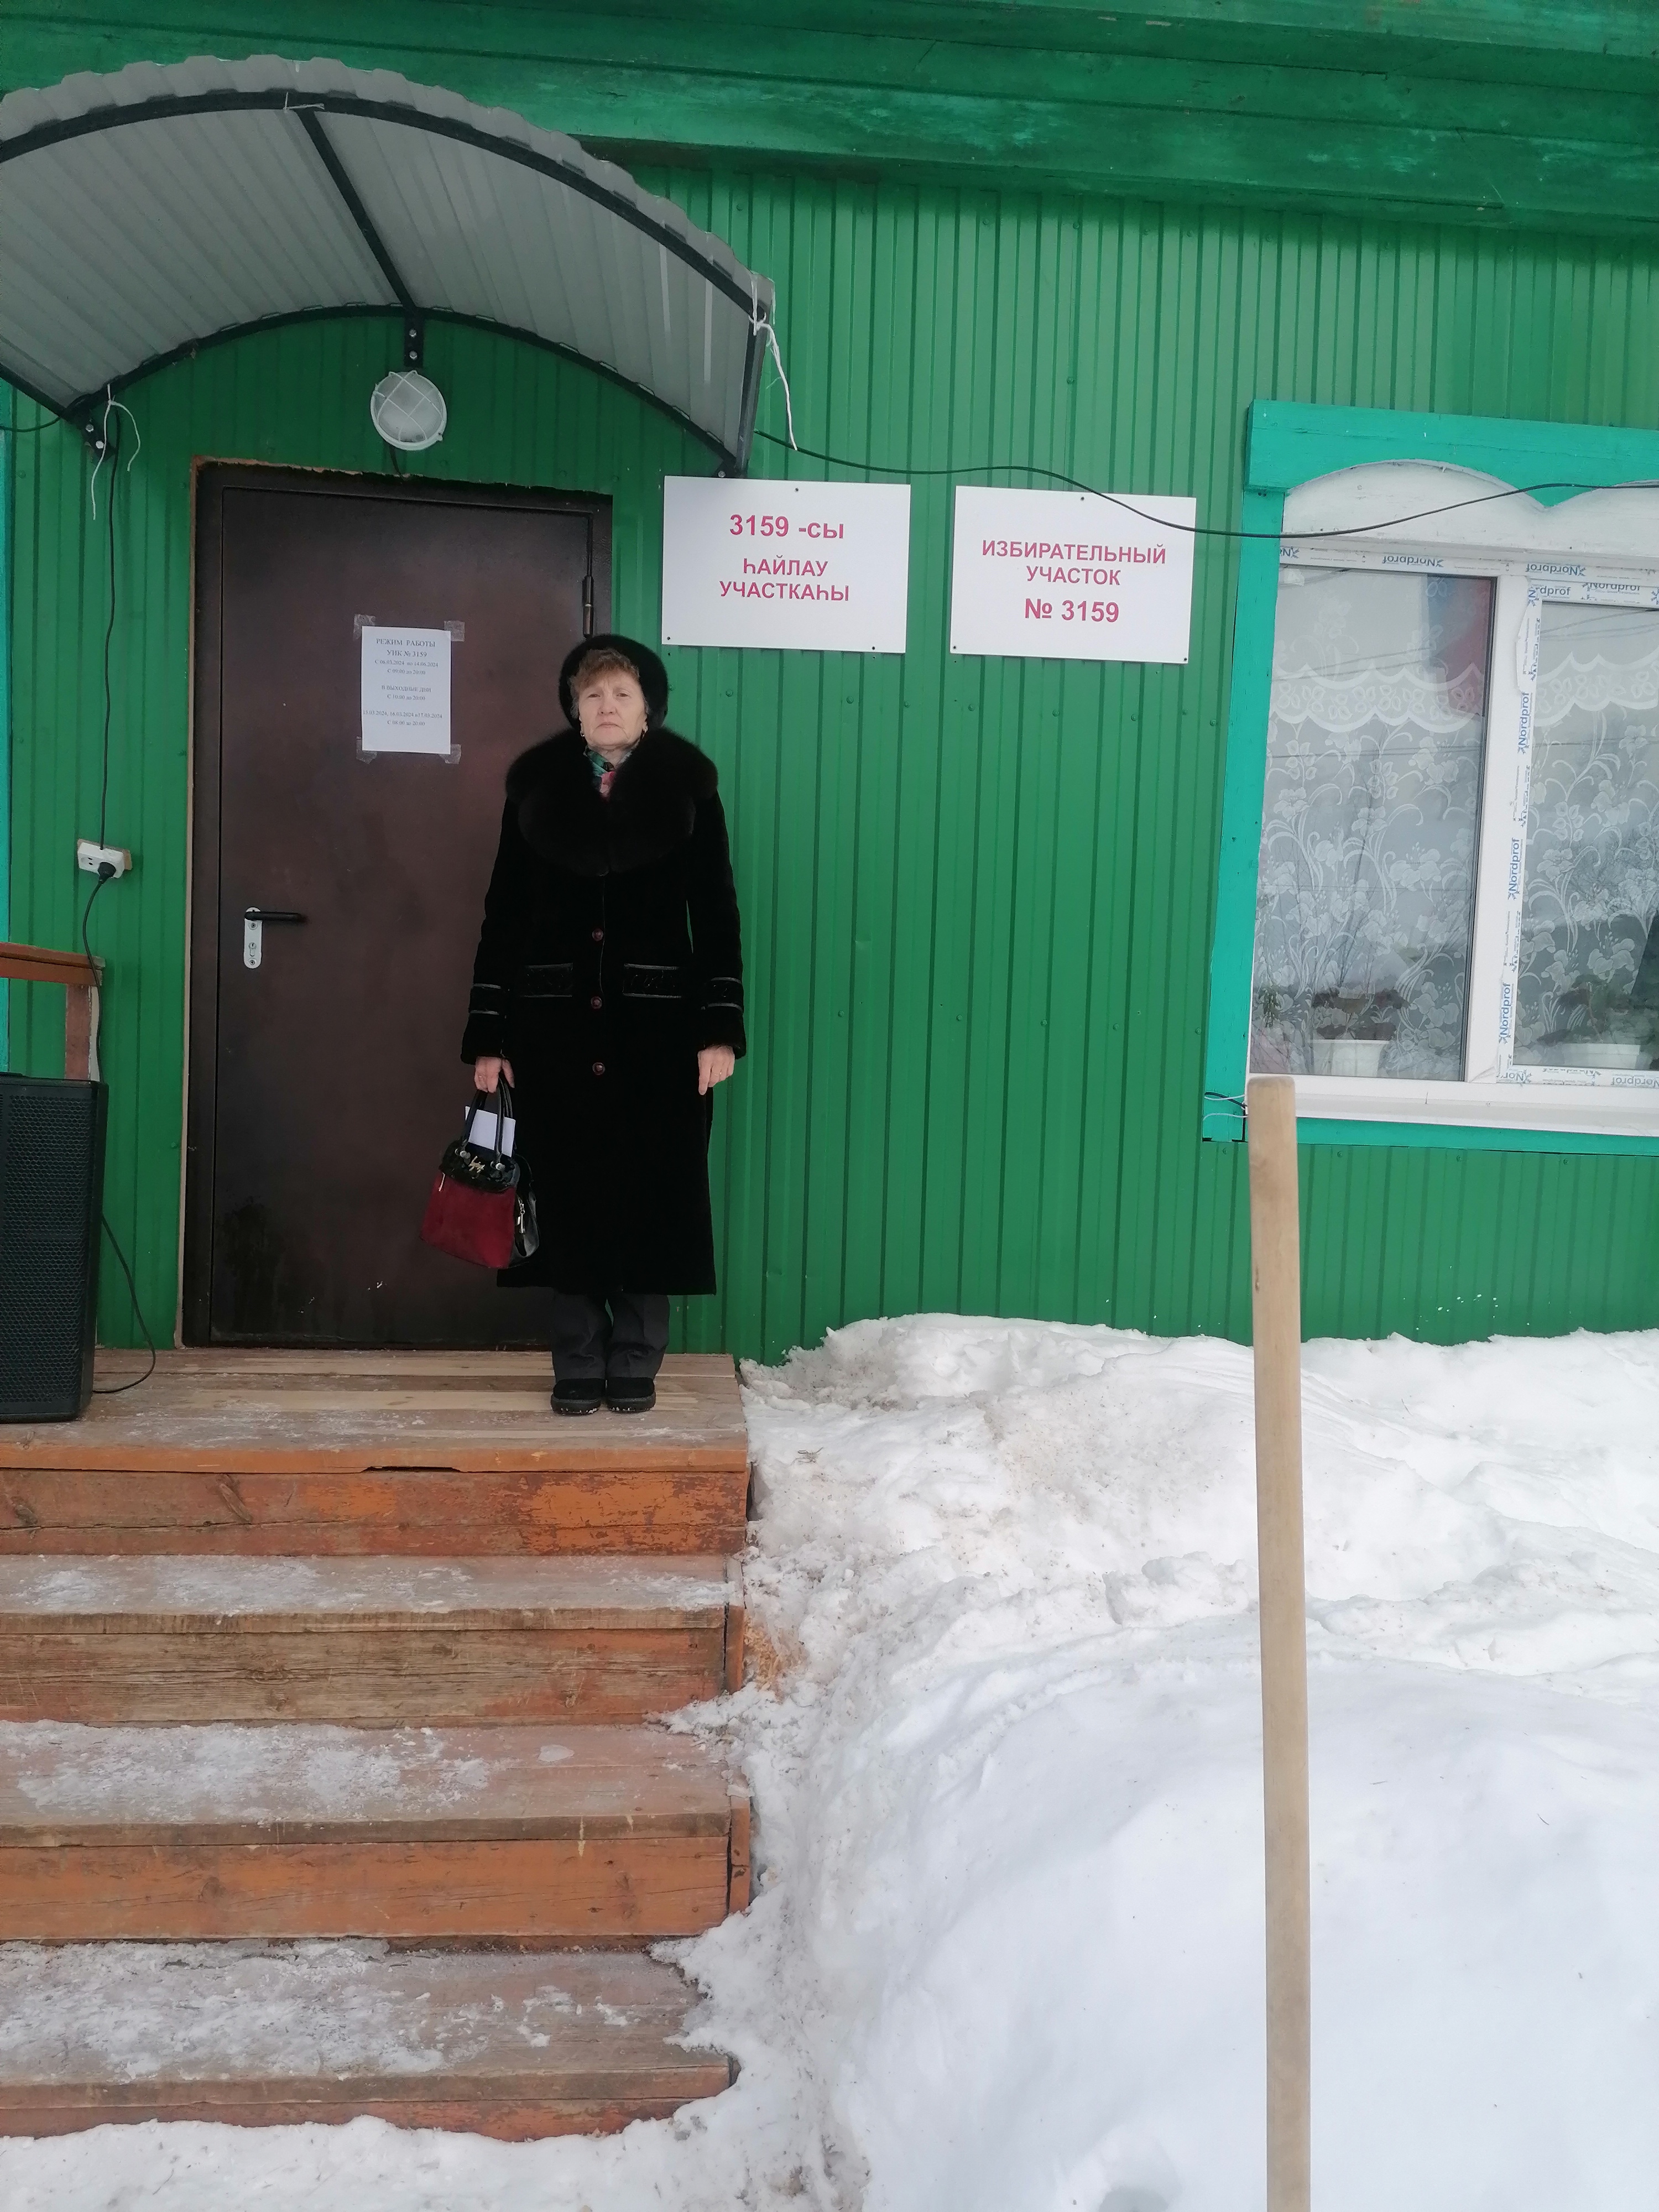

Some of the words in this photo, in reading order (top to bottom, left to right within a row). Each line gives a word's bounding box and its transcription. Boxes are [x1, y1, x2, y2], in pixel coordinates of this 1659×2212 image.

[729, 514, 789, 537] 3159
[799, 522, 844, 539] -сы
[982, 540, 1166, 564] ИЗБИРАТЕЛЬНЫЙ
[1382, 555, 1436, 567] Nordprof
[1026, 566, 1120, 585] УЧАСТОК
[1525, 564, 1578, 576] Nordprof
[1024, 598, 1053, 620] №
[1062, 599, 1119, 623] 3159
[1518, 692, 1530, 745] Nordprof
[1509, 837, 1520, 891] Nordprof
[1500, 982, 1511, 1036] Nordprof
